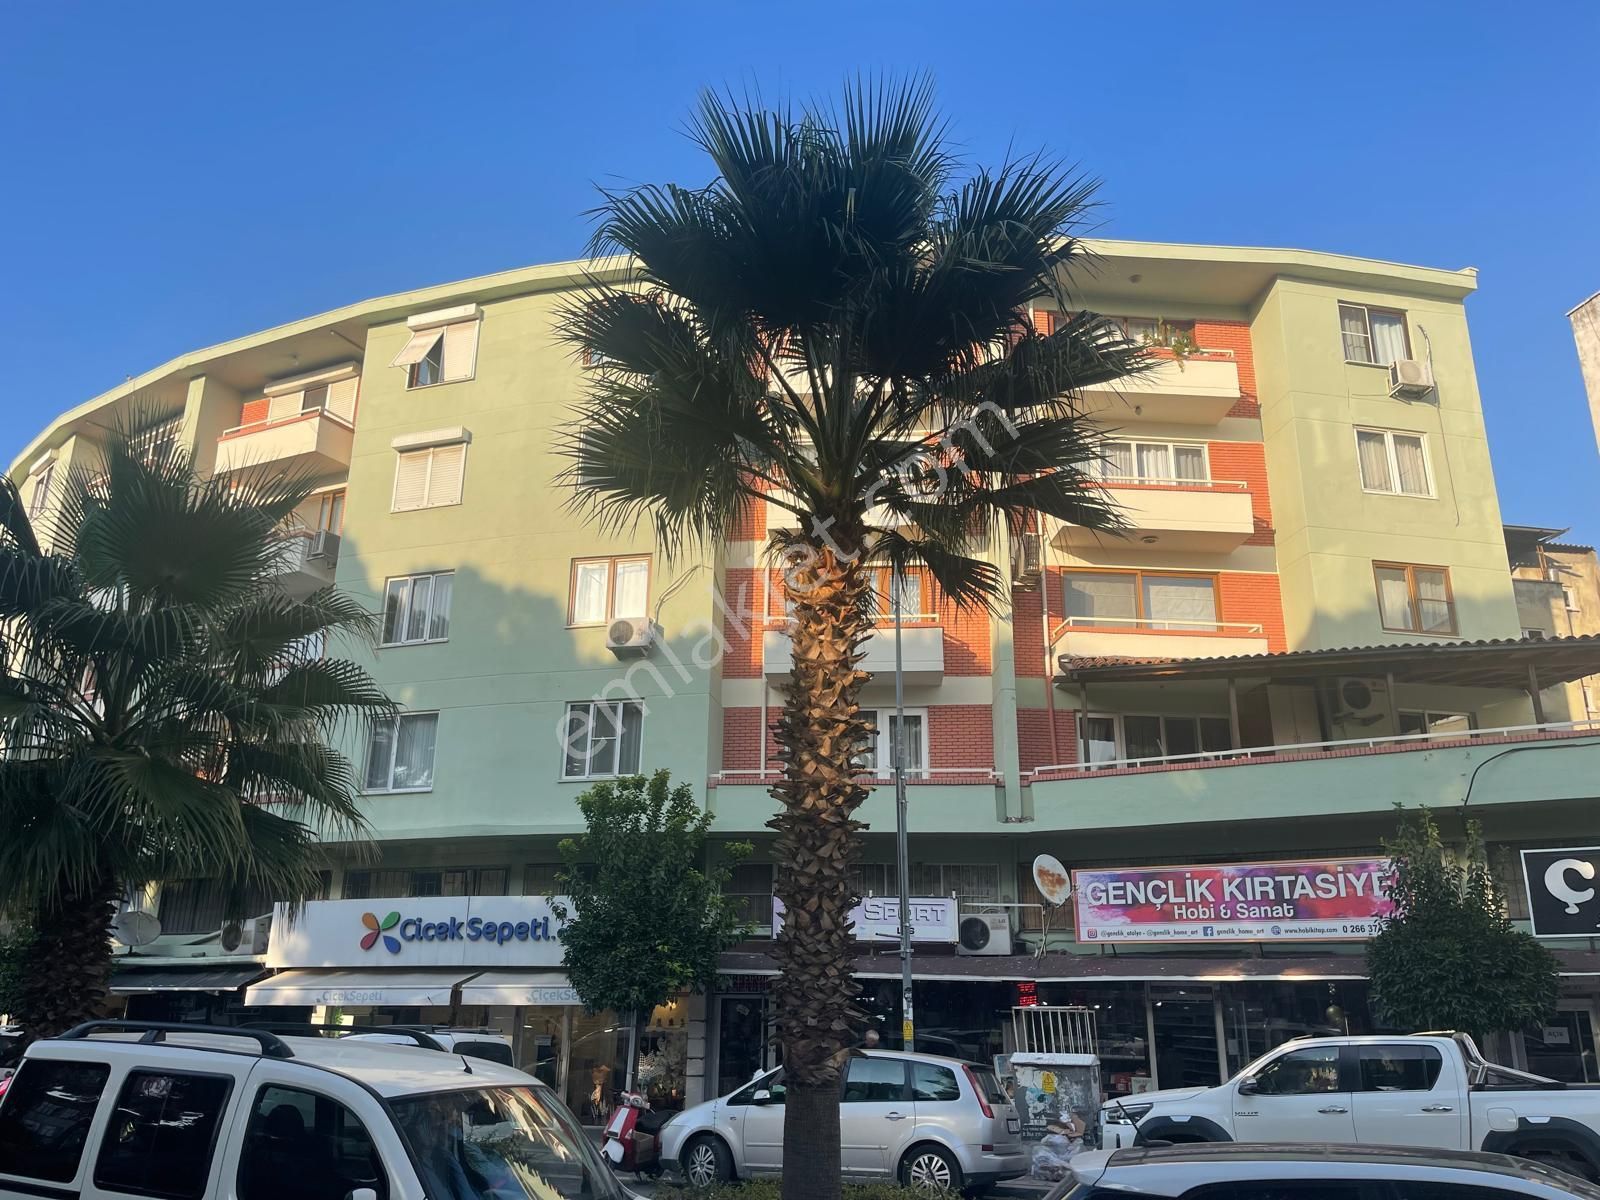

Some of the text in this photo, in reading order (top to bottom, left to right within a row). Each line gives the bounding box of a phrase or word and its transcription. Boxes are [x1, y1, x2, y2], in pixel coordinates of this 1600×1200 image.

[1085, 866, 1391, 911] GENÇLİK KIRTASİYE
[1544, 858, 1595, 915] Ç
[1174, 902, 1294, 920] Hobi & Sanat
[897, 927, 915, 935] LS
[1350, 925, 1366, 933] 266
